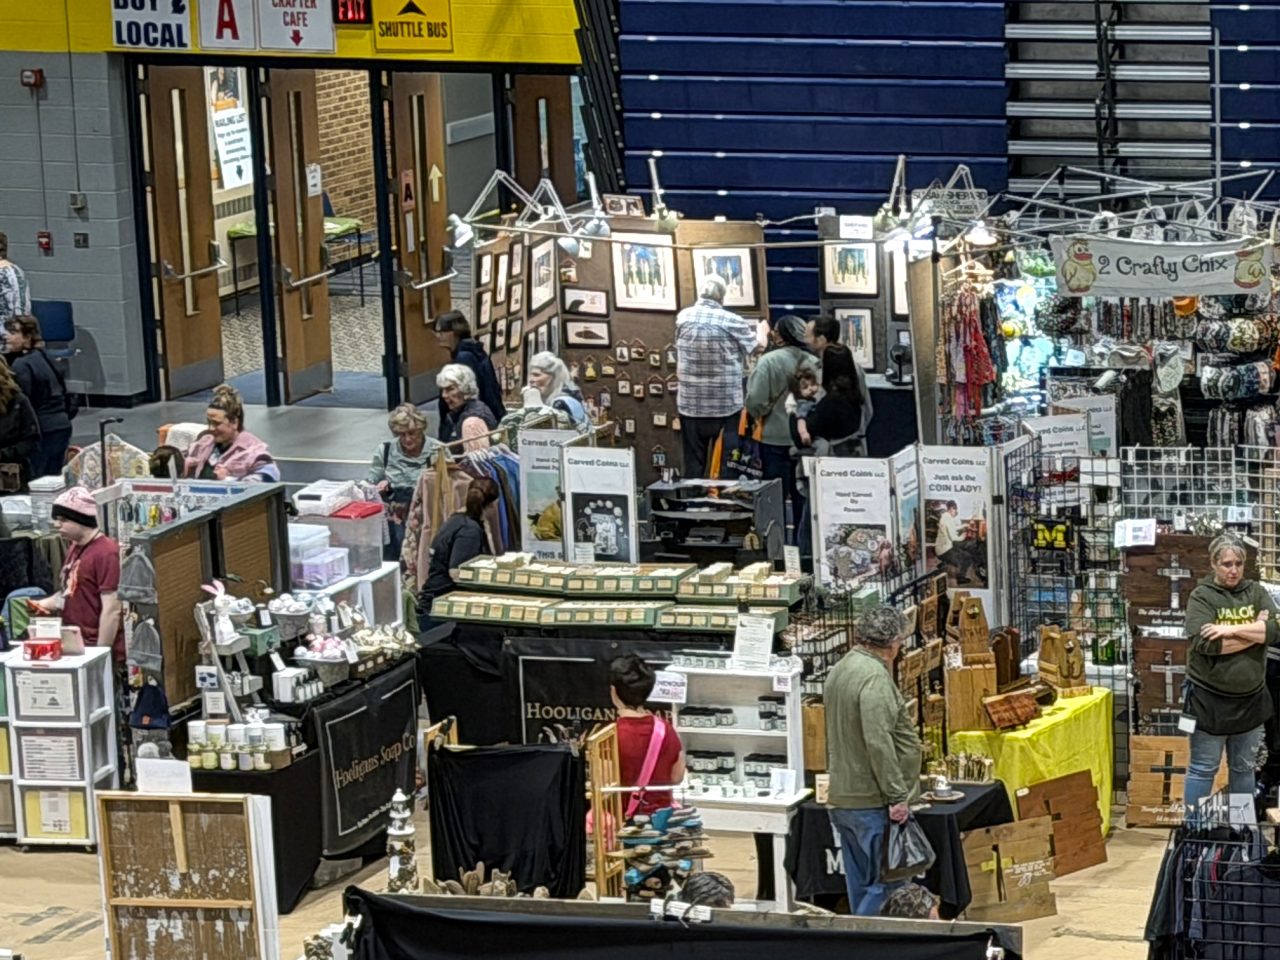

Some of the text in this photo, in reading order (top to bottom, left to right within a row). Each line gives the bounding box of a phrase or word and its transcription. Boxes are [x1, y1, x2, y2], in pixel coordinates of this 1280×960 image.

[283, 11, 308, 27] CAFE
[338, 0, 365, 20] EXIT
[216, 0, 239, 40] A
[115, 20, 188, 48] LOCAL
[378, 21, 448, 38] SHUTTLE BUS
[1098, 254, 1228, 282] 2 Crafty Chix
[568, 457, 594, 466] Carved
[596, 459, 618, 468] Coins
[922, 456, 950, 465] Carved
[951, 457, 974, 466] Coins
[820, 469, 848, 478] Carved
[850, 469, 873, 478] Coins
[928, 484, 981, 493] COIN LADY!
[1034, 523, 1067, 548] M
[335, 754, 379, 789] Hooligans
[380, 741, 402, 765] Soap
